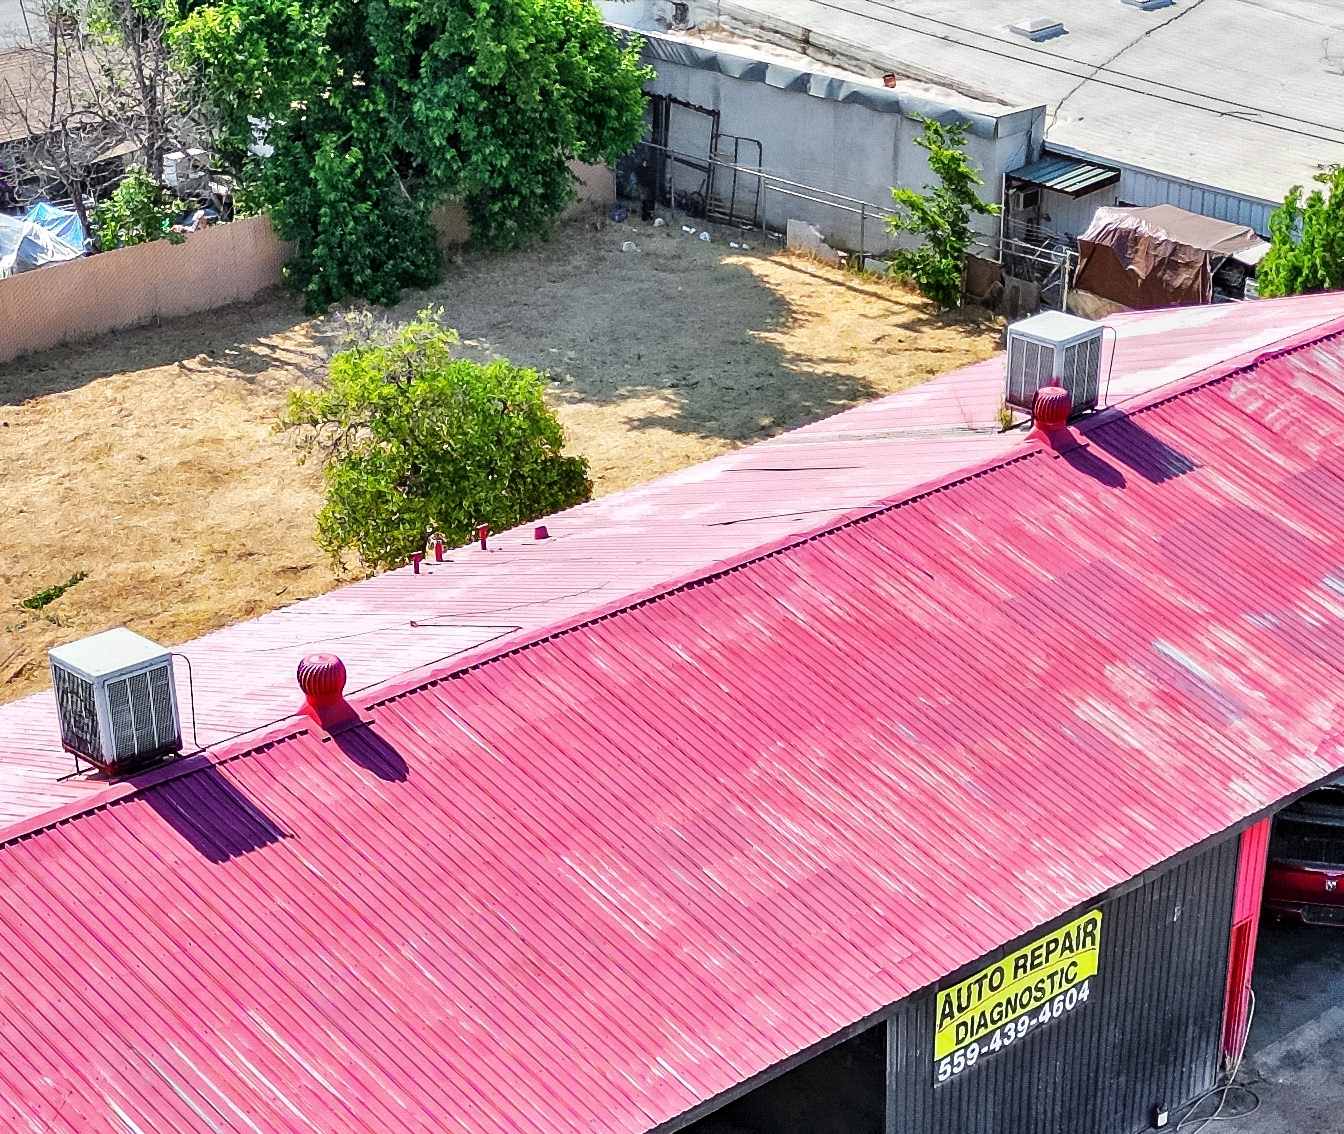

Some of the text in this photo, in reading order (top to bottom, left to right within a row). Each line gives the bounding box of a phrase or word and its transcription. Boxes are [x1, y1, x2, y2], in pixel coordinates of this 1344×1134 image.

[938, 916, 1097, 1026] AUTO REPAIR
[954, 960, 1079, 1047] DIAGNOSTIC
[938, 981, 1090, 1083] 559-439-4604
